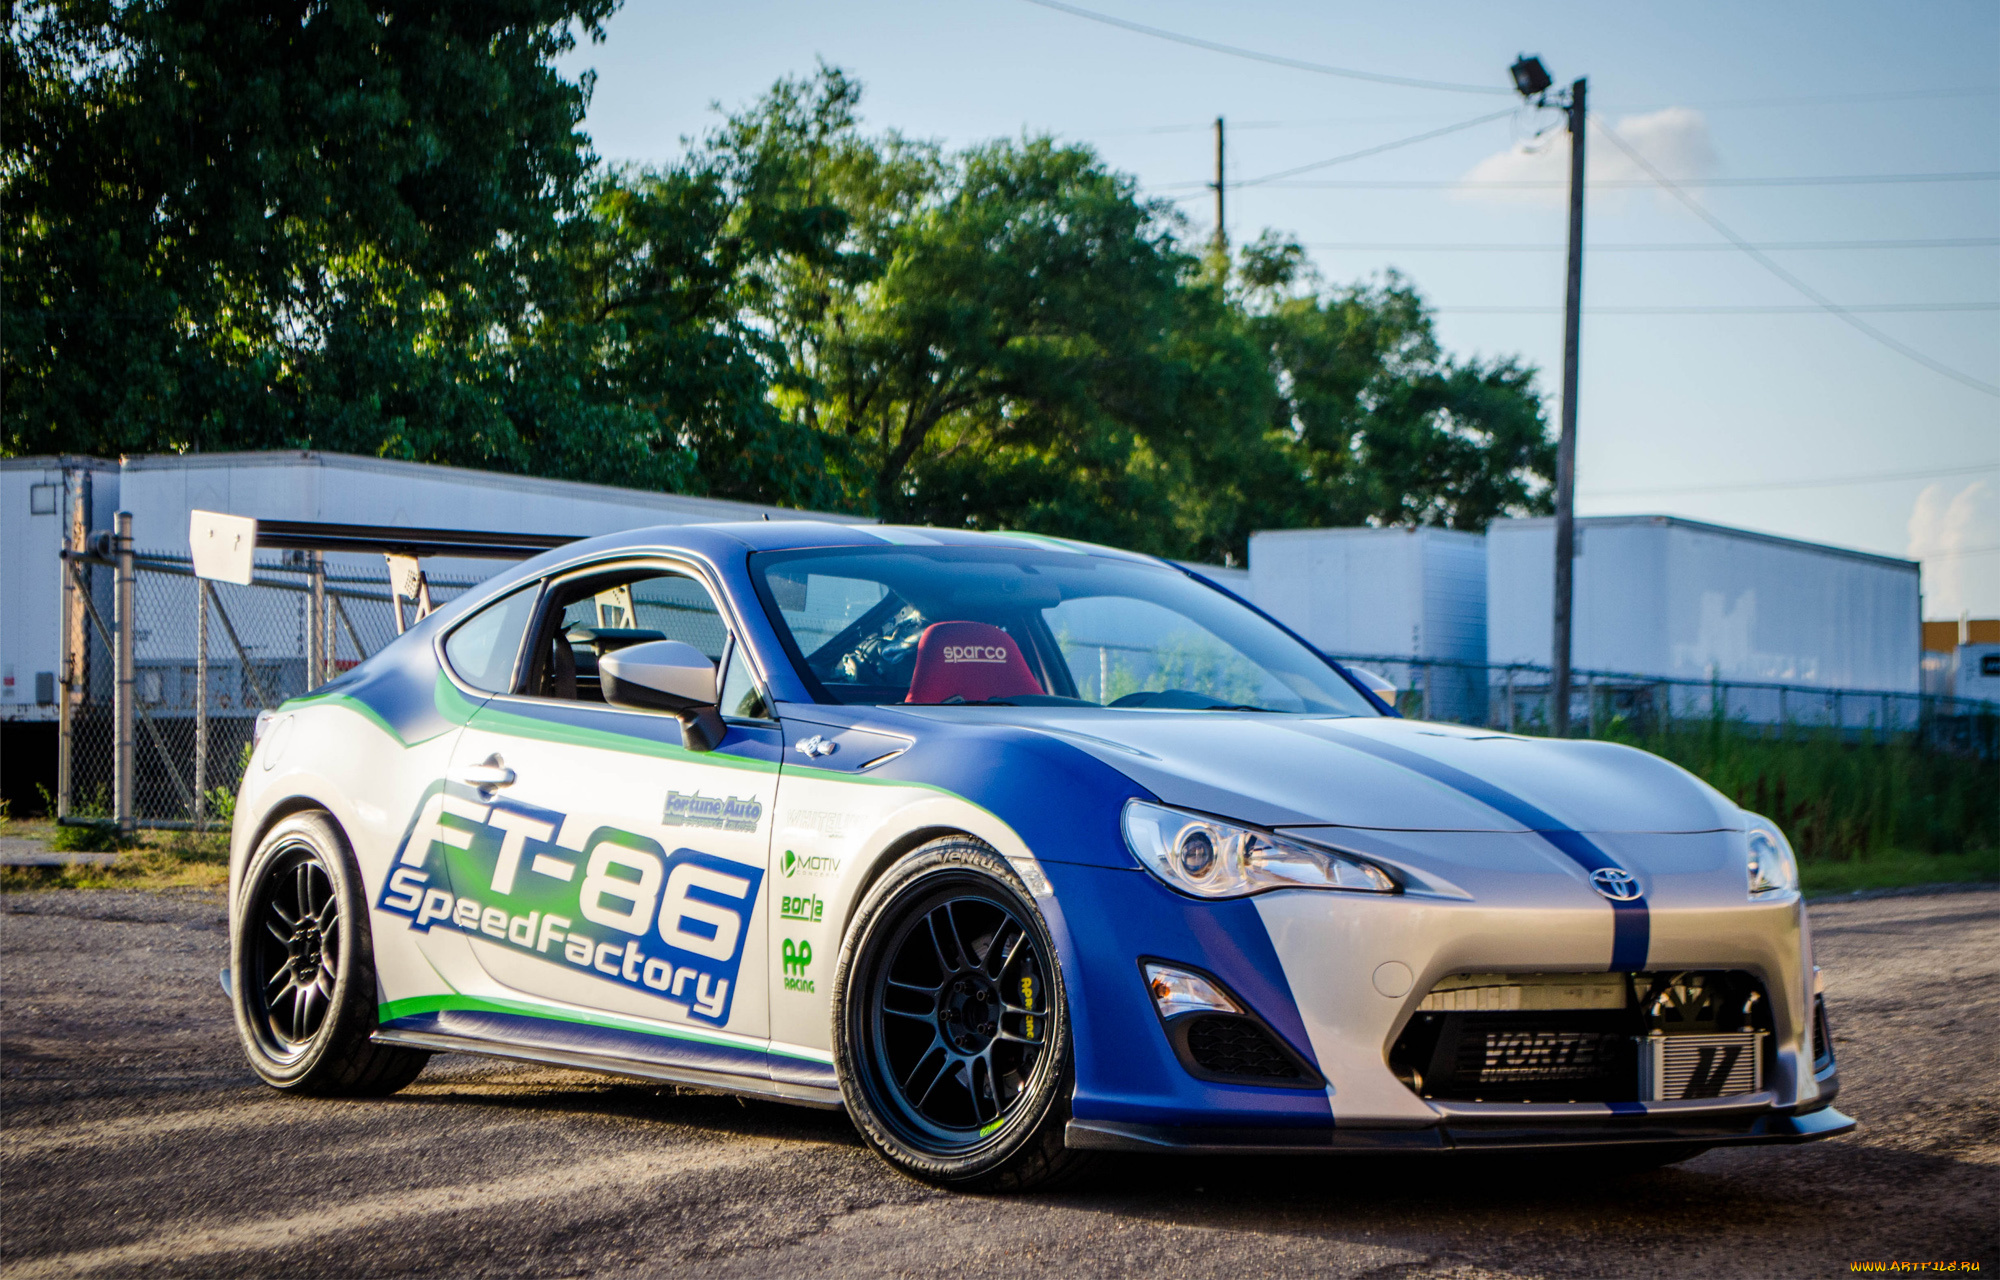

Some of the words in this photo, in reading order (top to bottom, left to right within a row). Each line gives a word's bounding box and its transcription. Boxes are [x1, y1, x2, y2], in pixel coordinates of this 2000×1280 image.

[943, 646, 1007, 663] sparco
[665, 790, 723, 817] Fortune
[723, 795, 761, 821] Auto
[400, 792, 751, 962] FT-86
[797, 856, 841, 872] MOTIV
[383, 867, 729, 1019] SpeedFactory
[782, 937, 813, 977] AP
